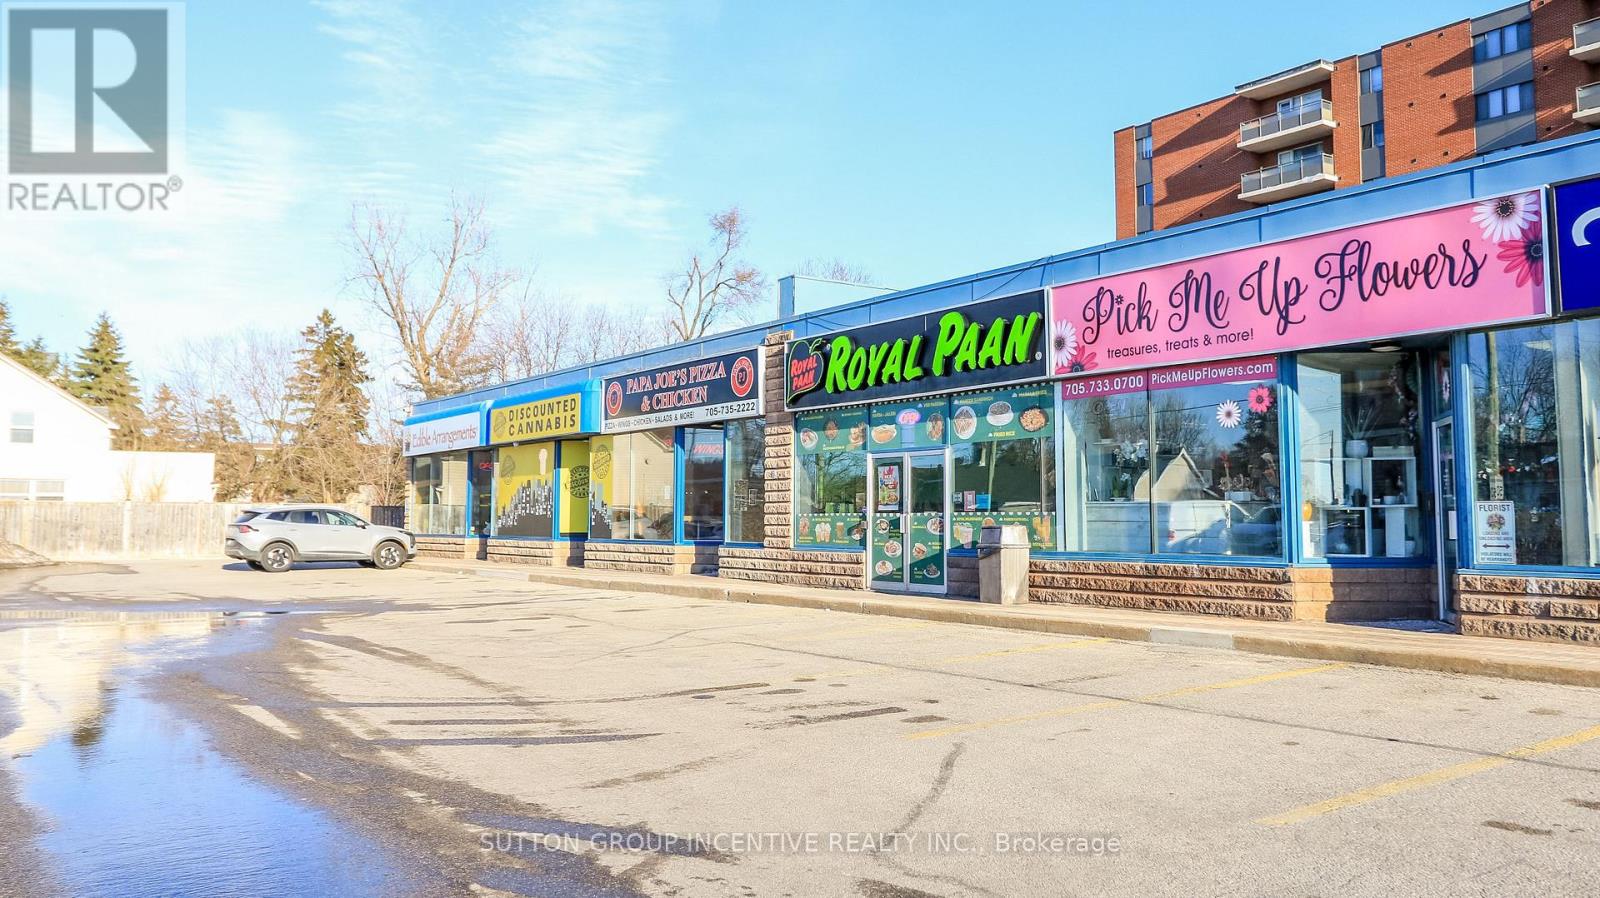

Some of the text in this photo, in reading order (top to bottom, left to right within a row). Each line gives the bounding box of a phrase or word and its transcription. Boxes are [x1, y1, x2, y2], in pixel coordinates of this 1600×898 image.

[1082, 239, 1487, 345] Pick Me Up Flowers
[825, 311, 1039, 394] ROYAL PAAN
[1107, 328, 1254, 359] treasures, treats & more!
[626, 376, 653, 395] PAPA
[653, 367, 687, 390] JOE'S
[689, 361, 726, 384] PIZZA
[791, 355, 817, 377] ROYAL
[1065, 361, 1273, 396] 705.733.0700 PickMeUpFlowers.com
[792, 370, 815, 390] PAAN
[508, 398, 577, 422] DISCOUNTED
[640, 385, 708, 412] & CHICKEN
[705, 401, 755, 417] 705-735-2222
[508, 414, 576, 436] CANNABIS
[655, 414, 672, 423] SALADS
